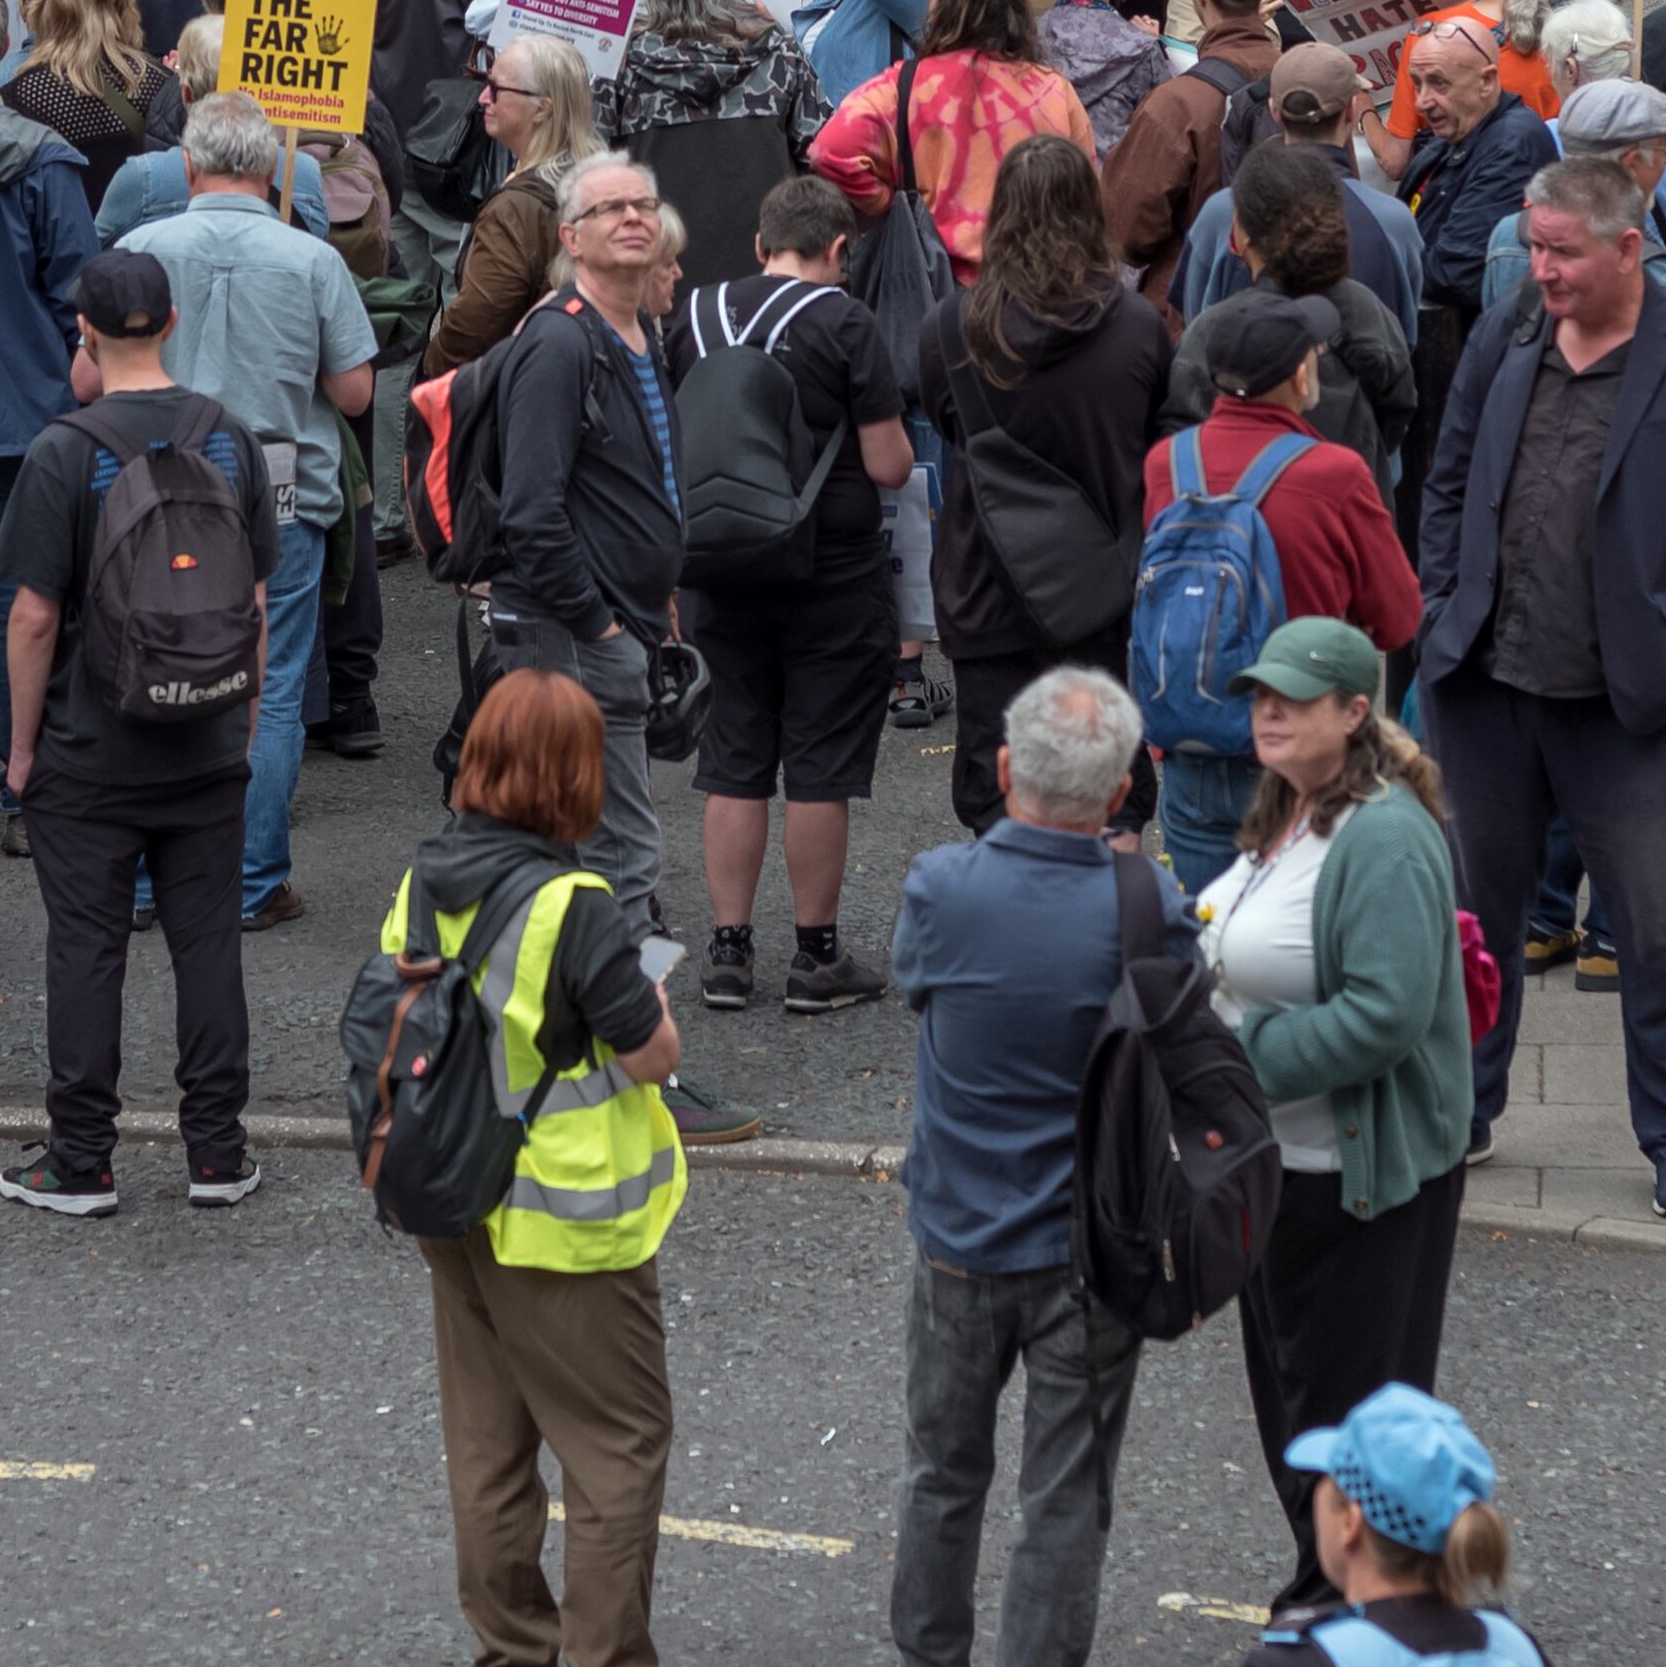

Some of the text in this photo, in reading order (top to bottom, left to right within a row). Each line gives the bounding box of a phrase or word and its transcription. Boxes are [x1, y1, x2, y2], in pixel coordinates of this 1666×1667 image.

[540, 3, 553, 14] YES
[553, 6, 563, 16] TO
[563, 8, 598, 25] DIVERSITY
[244, 18, 308, 54] FAR
[240, 52, 348, 92] RIGHT
[258, 88, 345, 108] Islamophobia
[264, 107, 341, 124] ntisemitism
[147, 668, 250, 707] ellesse
